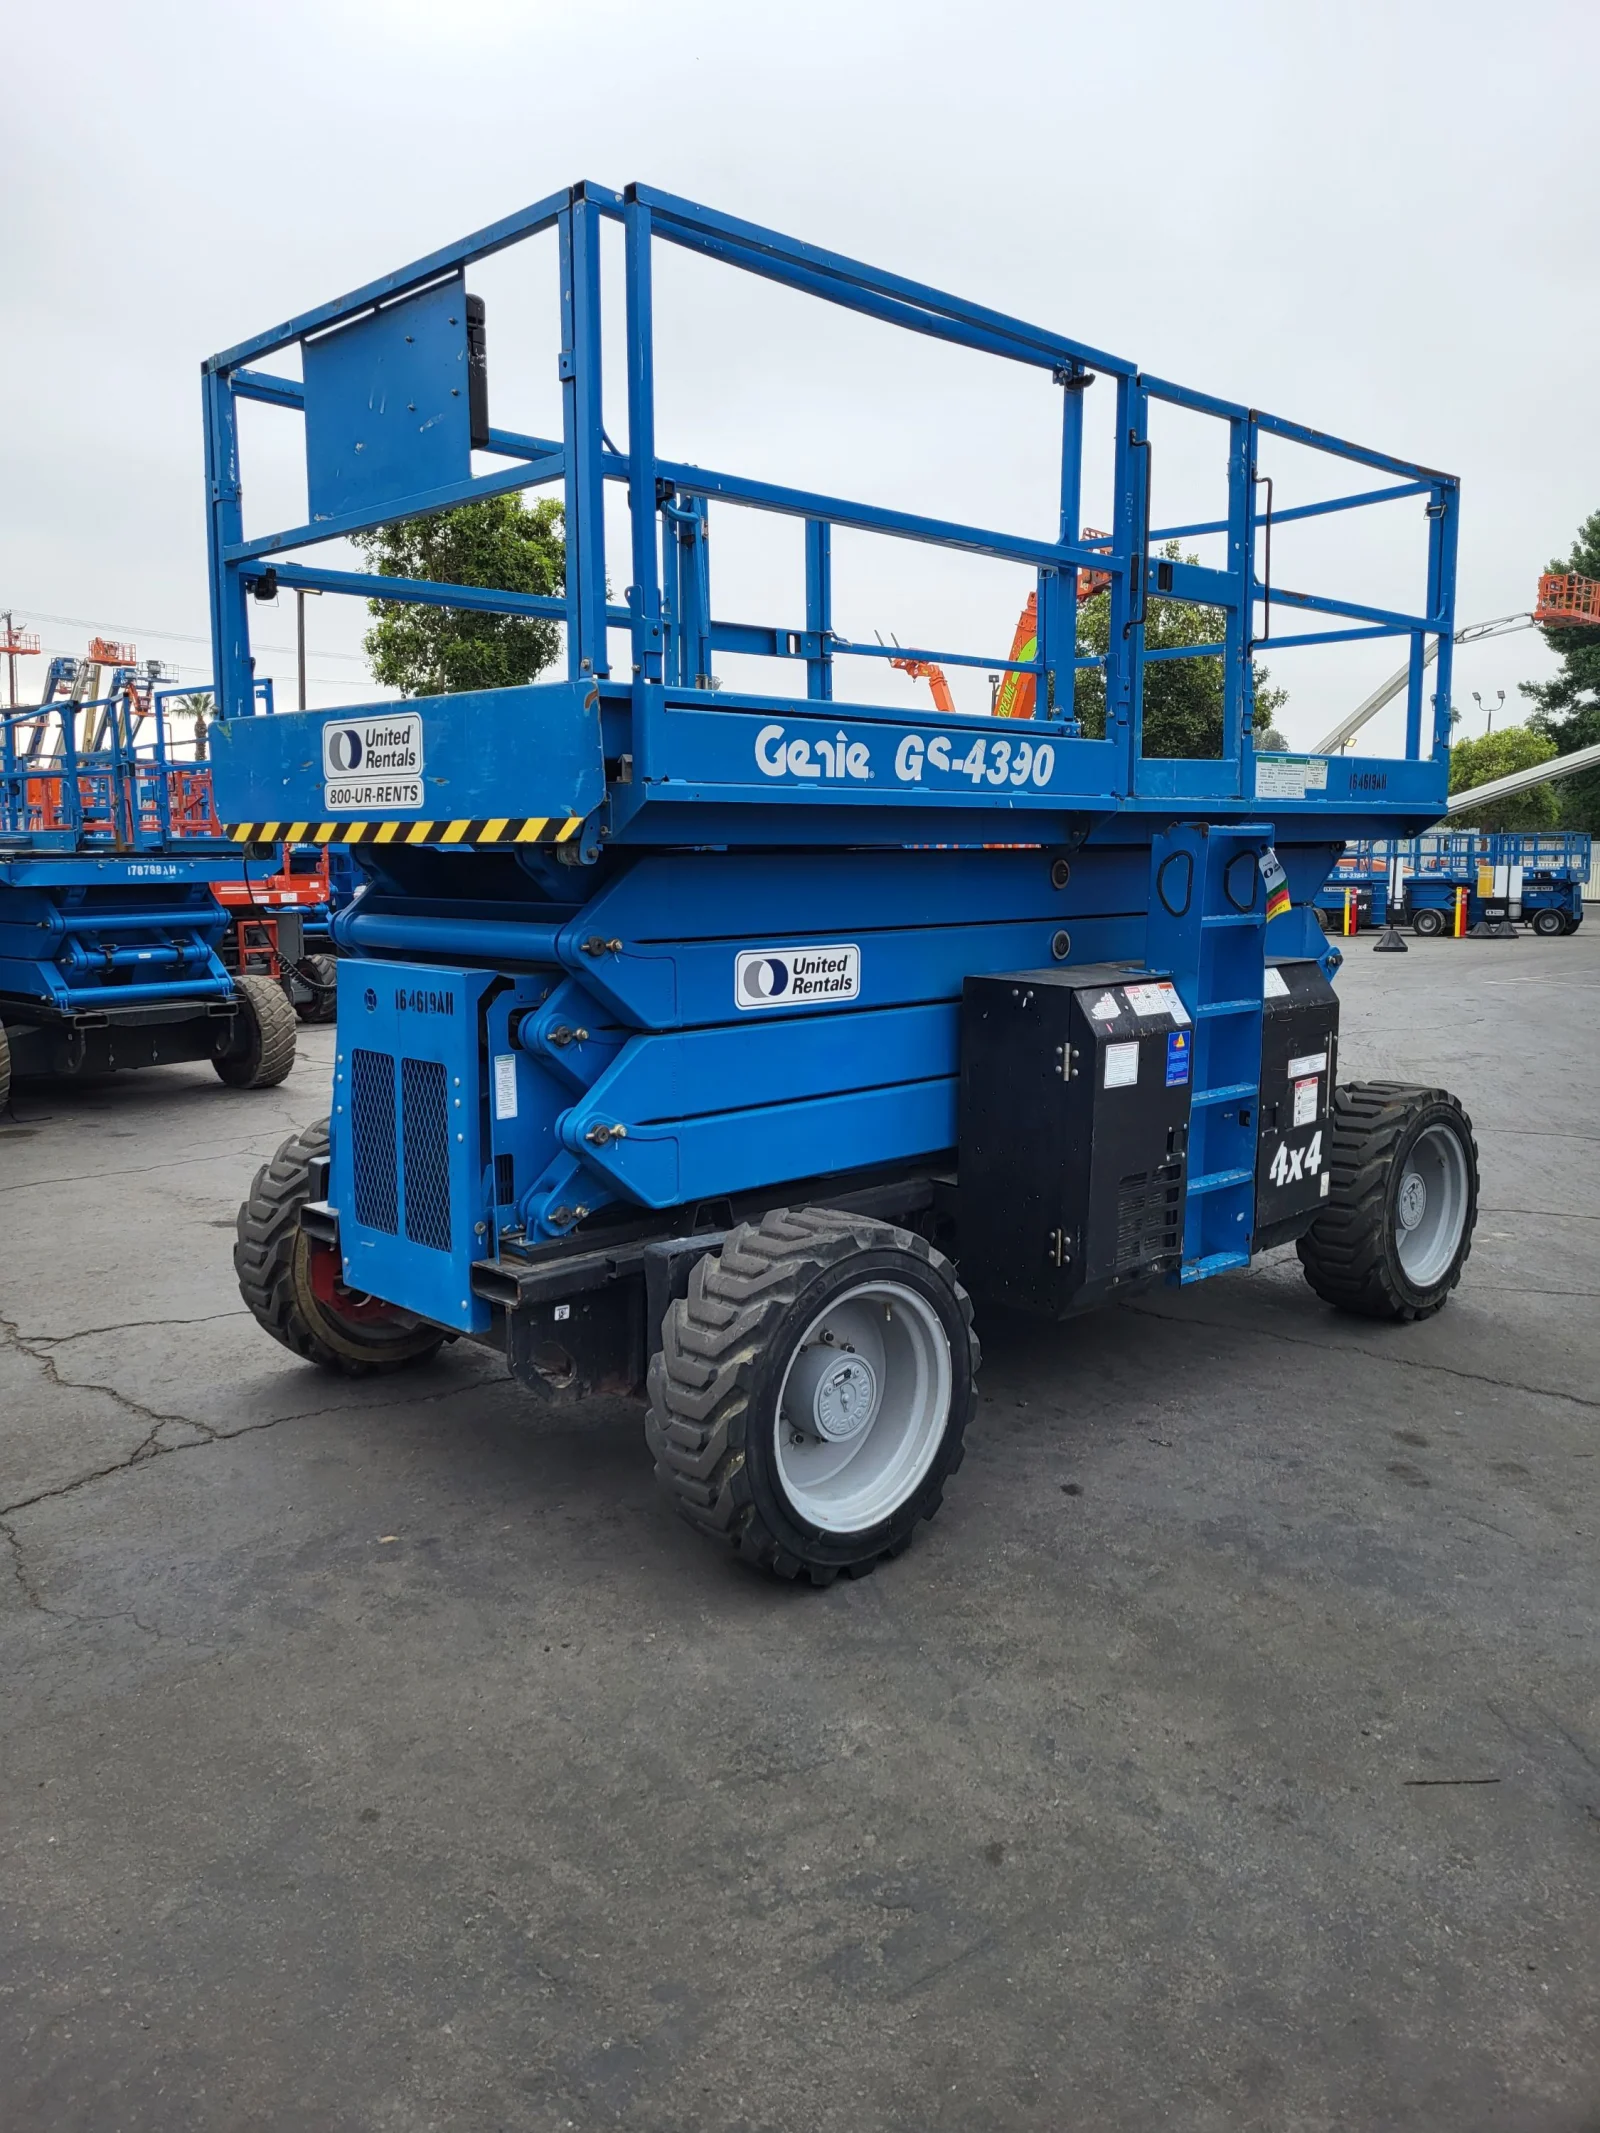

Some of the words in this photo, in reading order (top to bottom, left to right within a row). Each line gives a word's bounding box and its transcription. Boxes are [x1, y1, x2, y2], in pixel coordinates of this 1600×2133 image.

[365, 724, 412, 748] United
[365, 747, 416, 769] Rentals
[754, 724, 870, 779] Genie
[895, 734, 1055, 786] GS-4390
[329, 784, 418, 805] 800-UR-RENTS
[793, 955, 848, 975] United
[792, 974, 853, 995] Rentals
[1269, 1130, 1323, 1187] 4x4
